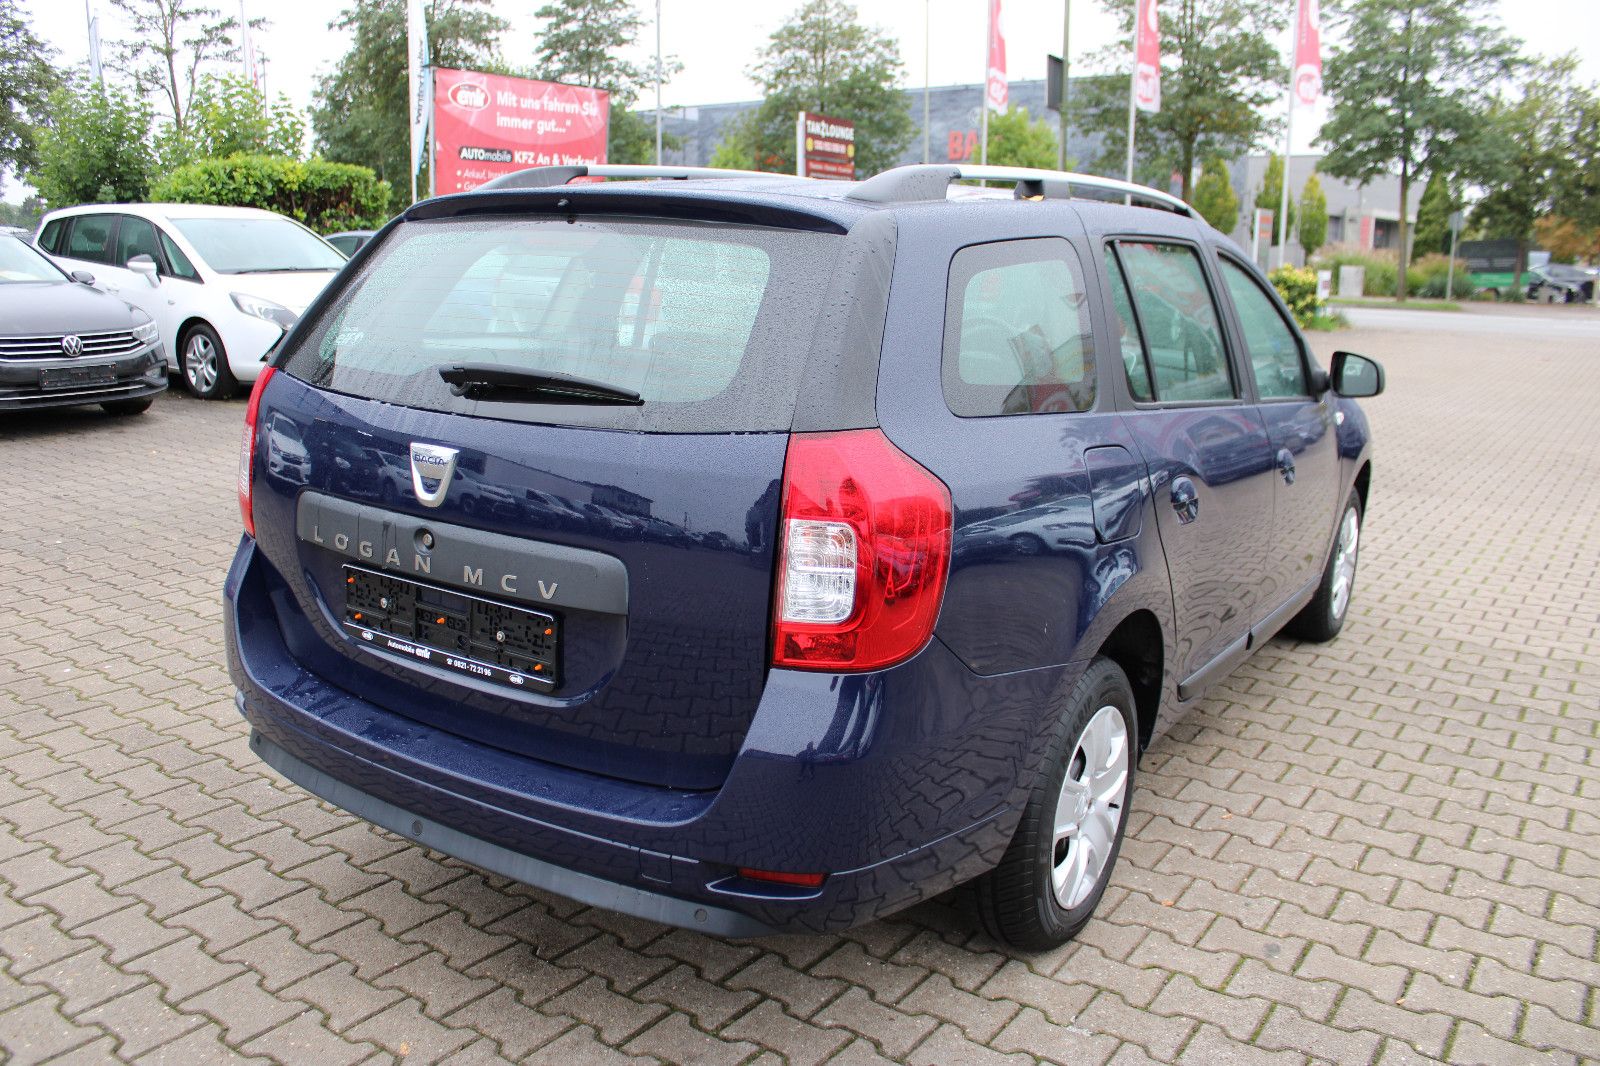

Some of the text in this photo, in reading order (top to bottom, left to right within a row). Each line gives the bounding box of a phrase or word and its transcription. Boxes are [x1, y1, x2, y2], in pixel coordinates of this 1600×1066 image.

[496, 91, 517, 108] Mit
[520, 97, 541, 110] uns
[543, 96, 579, 114] fahren
[496, 112, 534, 130] immer
[514, 150, 535, 165] KFZ
[537, 153, 551, 166] An
[414, 453, 446, 466] DACIA
[313, 524, 559, 600] LOGAN MCV
[387, 639, 415, 654] Automobile
[415, 647, 431, 660] emir
